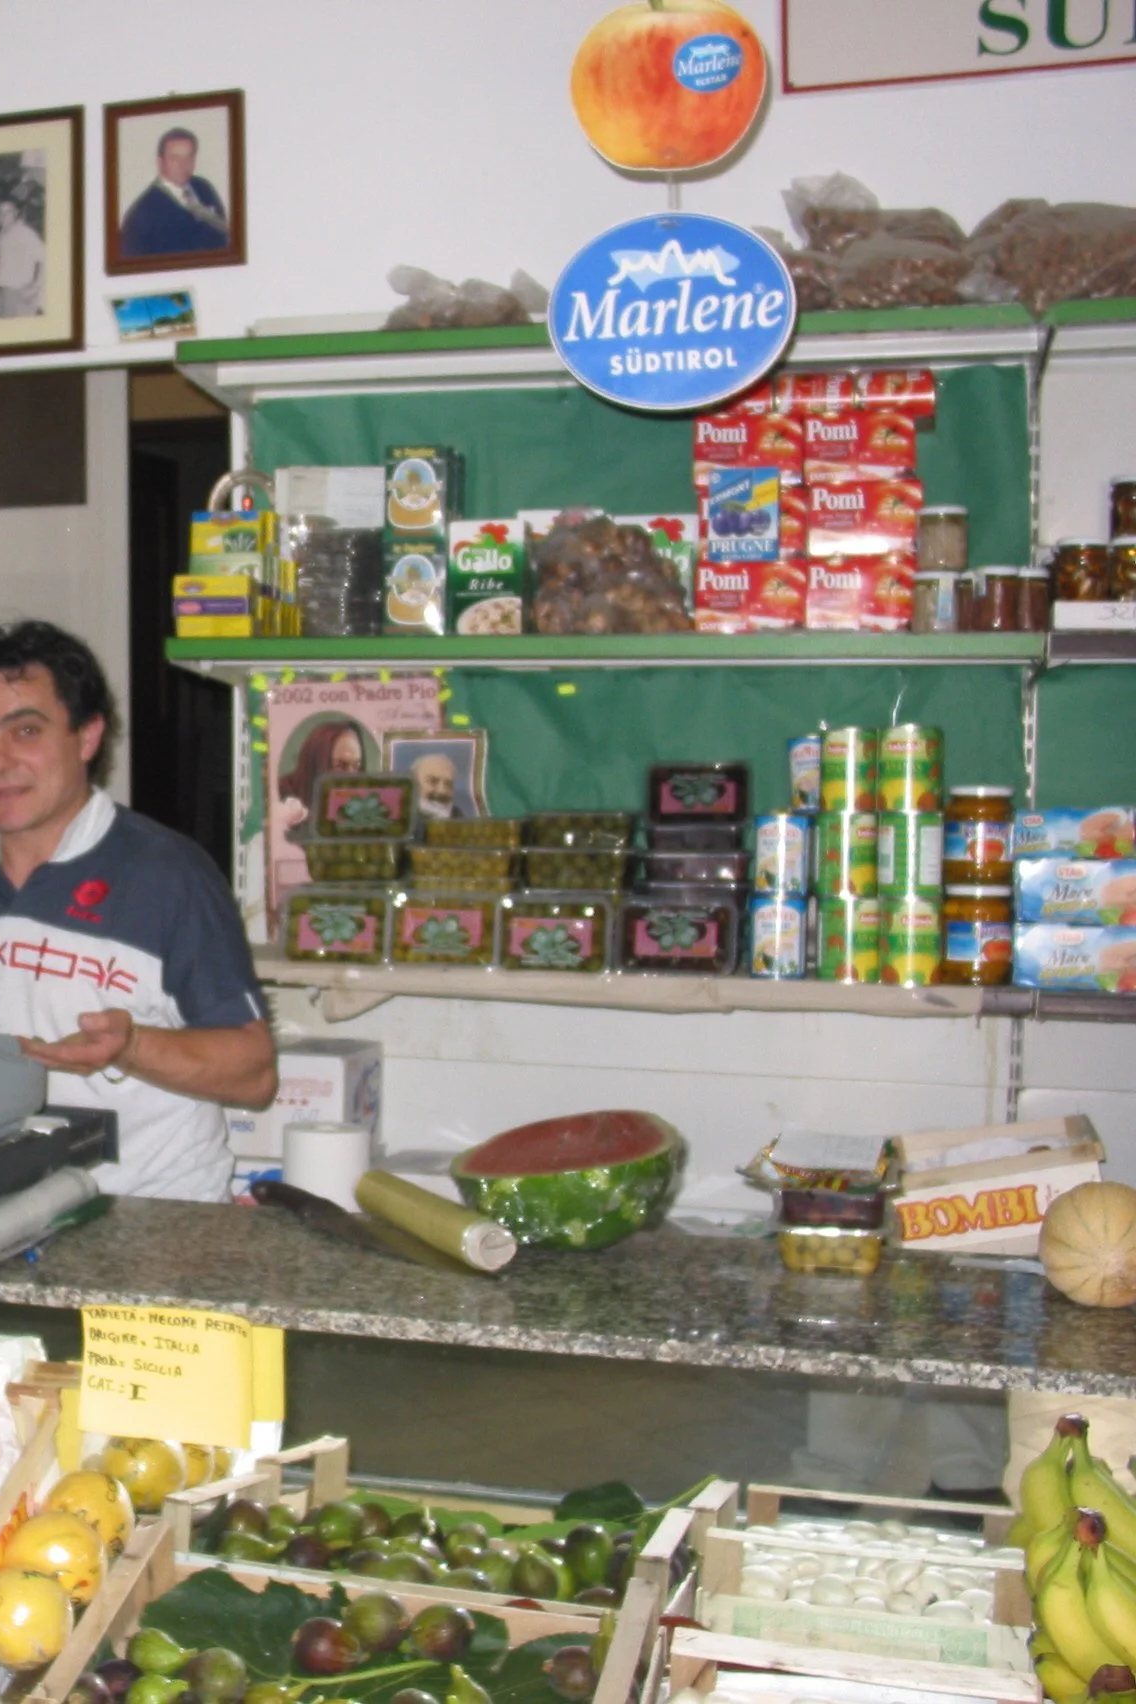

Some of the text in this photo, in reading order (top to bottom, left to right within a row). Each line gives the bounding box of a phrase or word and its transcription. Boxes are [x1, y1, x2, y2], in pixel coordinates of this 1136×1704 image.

[977, 0, 1136, 57] SU
[564, 279, 784, 342] Marlene
[610, 347, 737, 375] SÜDTIROL
[697, 421, 747, 444] Pomì
[806, 418, 858, 442] Pomì
[813, 487, 864, 511] Pomì
[710, 539, 772, 553] PRUGNE
[455, 546, 512, 573] Gallo
[698, 567, 750, 591] Pomì
[809, 565, 862, 590] Pomì
[896, 1184, 1044, 1242] BOMBI
